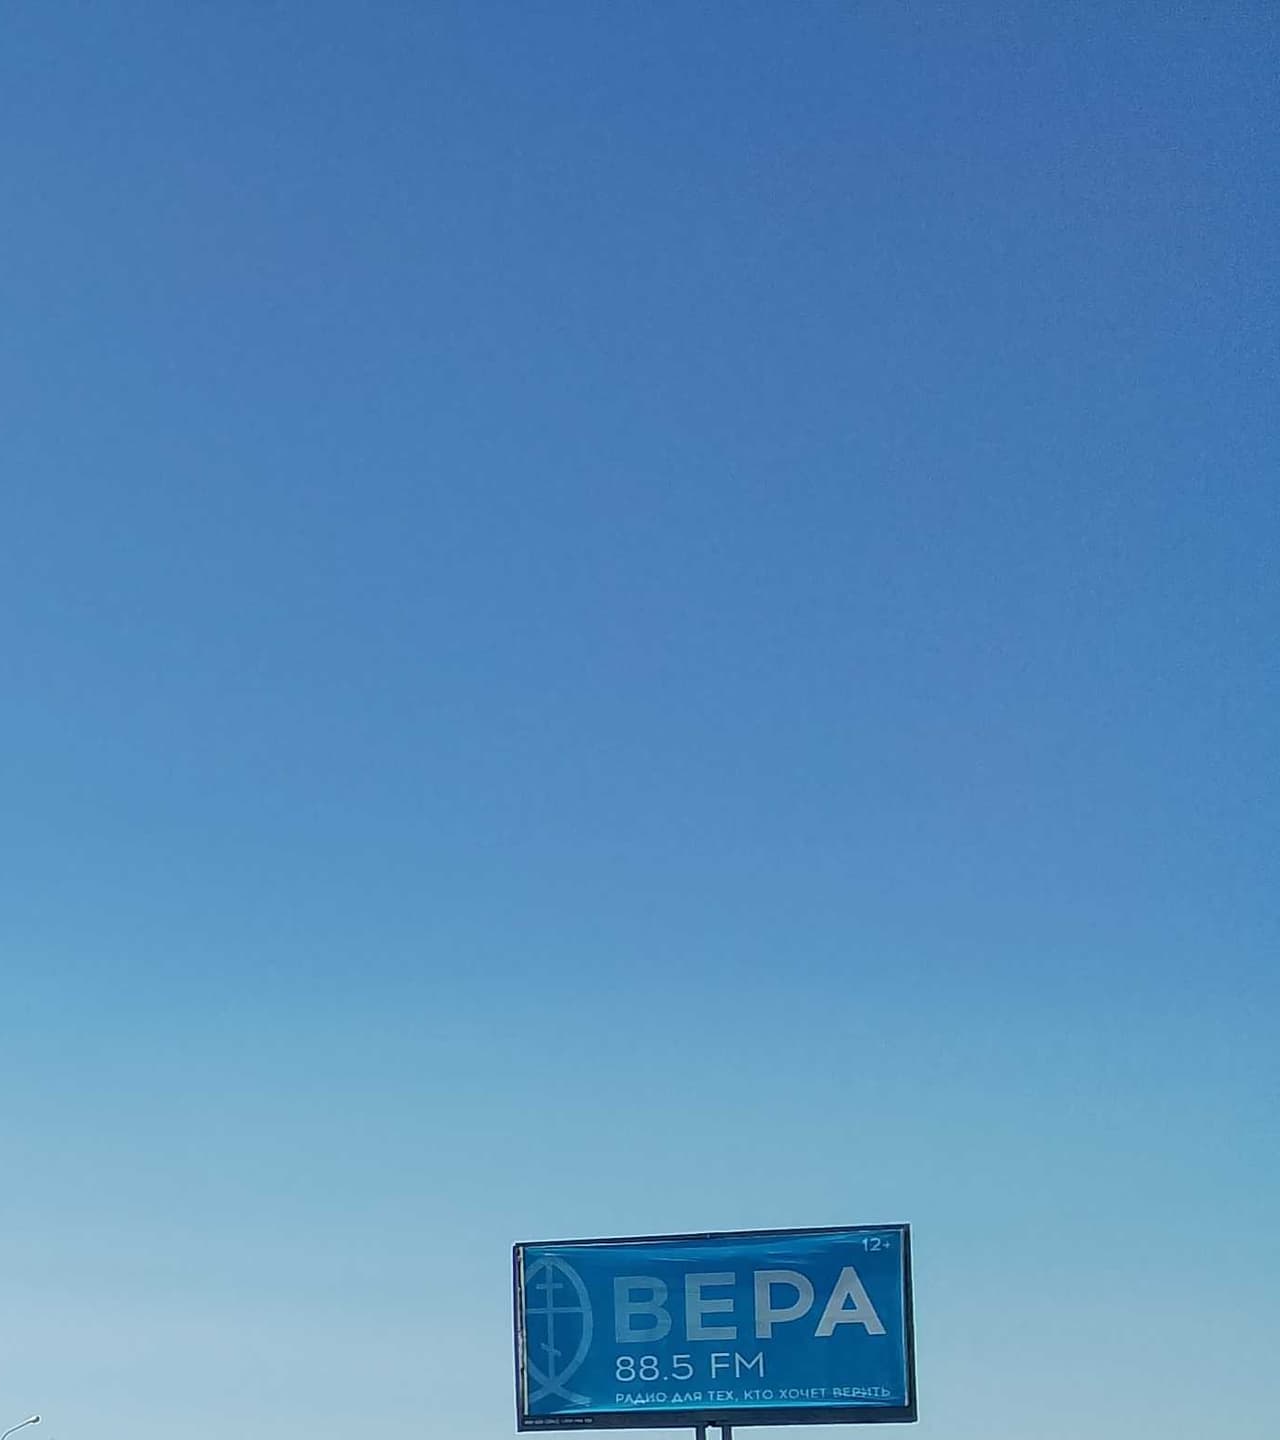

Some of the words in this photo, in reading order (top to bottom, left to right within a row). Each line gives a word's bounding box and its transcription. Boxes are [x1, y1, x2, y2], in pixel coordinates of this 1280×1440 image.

[862, 1237, 890, 1252] 12+
[613, 1266, 887, 1344] ВЕРА
[615, 1354, 694, 1381] 88.5
[710, 1351, 765, 1380] FM
[615, 1391, 668, 1405] РАДИО
[672, 1391, 703, 1404] ДЛЯ
[706, 1390, 739, 1402] ТЕХ,
[744, 1388, 774, 1401] КТО
[779, 1387, 826, 1399] ХОЧЕТ
[832, 1386, 891, 1398] ВЕРИТЬ
